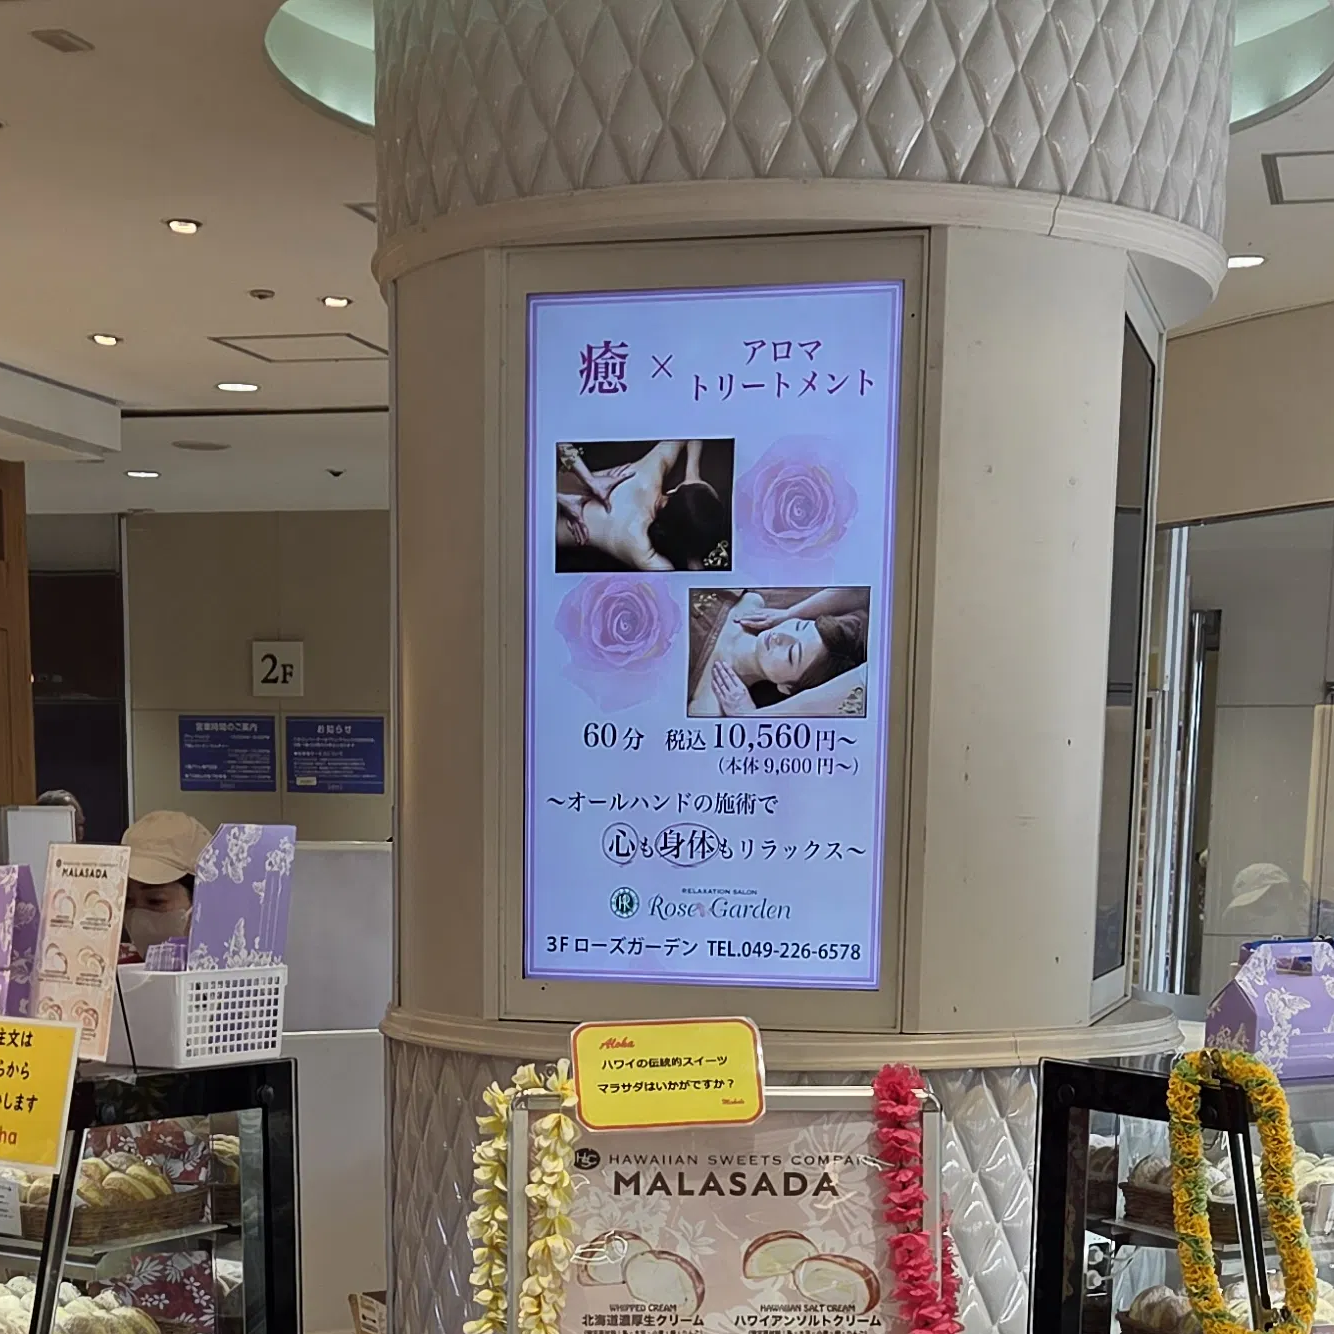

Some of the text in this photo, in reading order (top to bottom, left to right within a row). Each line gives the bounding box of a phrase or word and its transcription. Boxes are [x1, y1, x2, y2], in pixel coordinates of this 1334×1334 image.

[744, 338, 822, 366] アロマ
[579, 340, 629, 396] 癒
[692, 368, 875, 402] トリートメント
[260, 653, 294, 685] 2F
[316, 724, 353, 735] お知らせ
[582, 721, 645, 751] 60分
[61, 867, 108, 879] MALASADA
[681, 887, 758, 896] RELAXATION SALON
[648, 894, 792, 921] Rose Garden
[546, 936, 862, 962] 3F ローズガーデン TEL.049-226-6578
[599, 1036, 635, 1050] Aloha
[601, 1055, 728, 1071] ハワイの伝統的スイーツ
[609, 1154, 698, 1166] HAWAIIAN
[708, 1154, 782, 1166] SWEETS
[613, 1171, 839, 1197] MALASADA
[609, 1304, 677, 1312] WHIPPED CREAM
[760, 1304, 856, 1312] HAWAIIAN SALT CREAM
[582, 1314, 705, 1327] 北海道濃厚生クリーム
[734, 1314, 882, 1327] ハワイアンソルトクリーム
